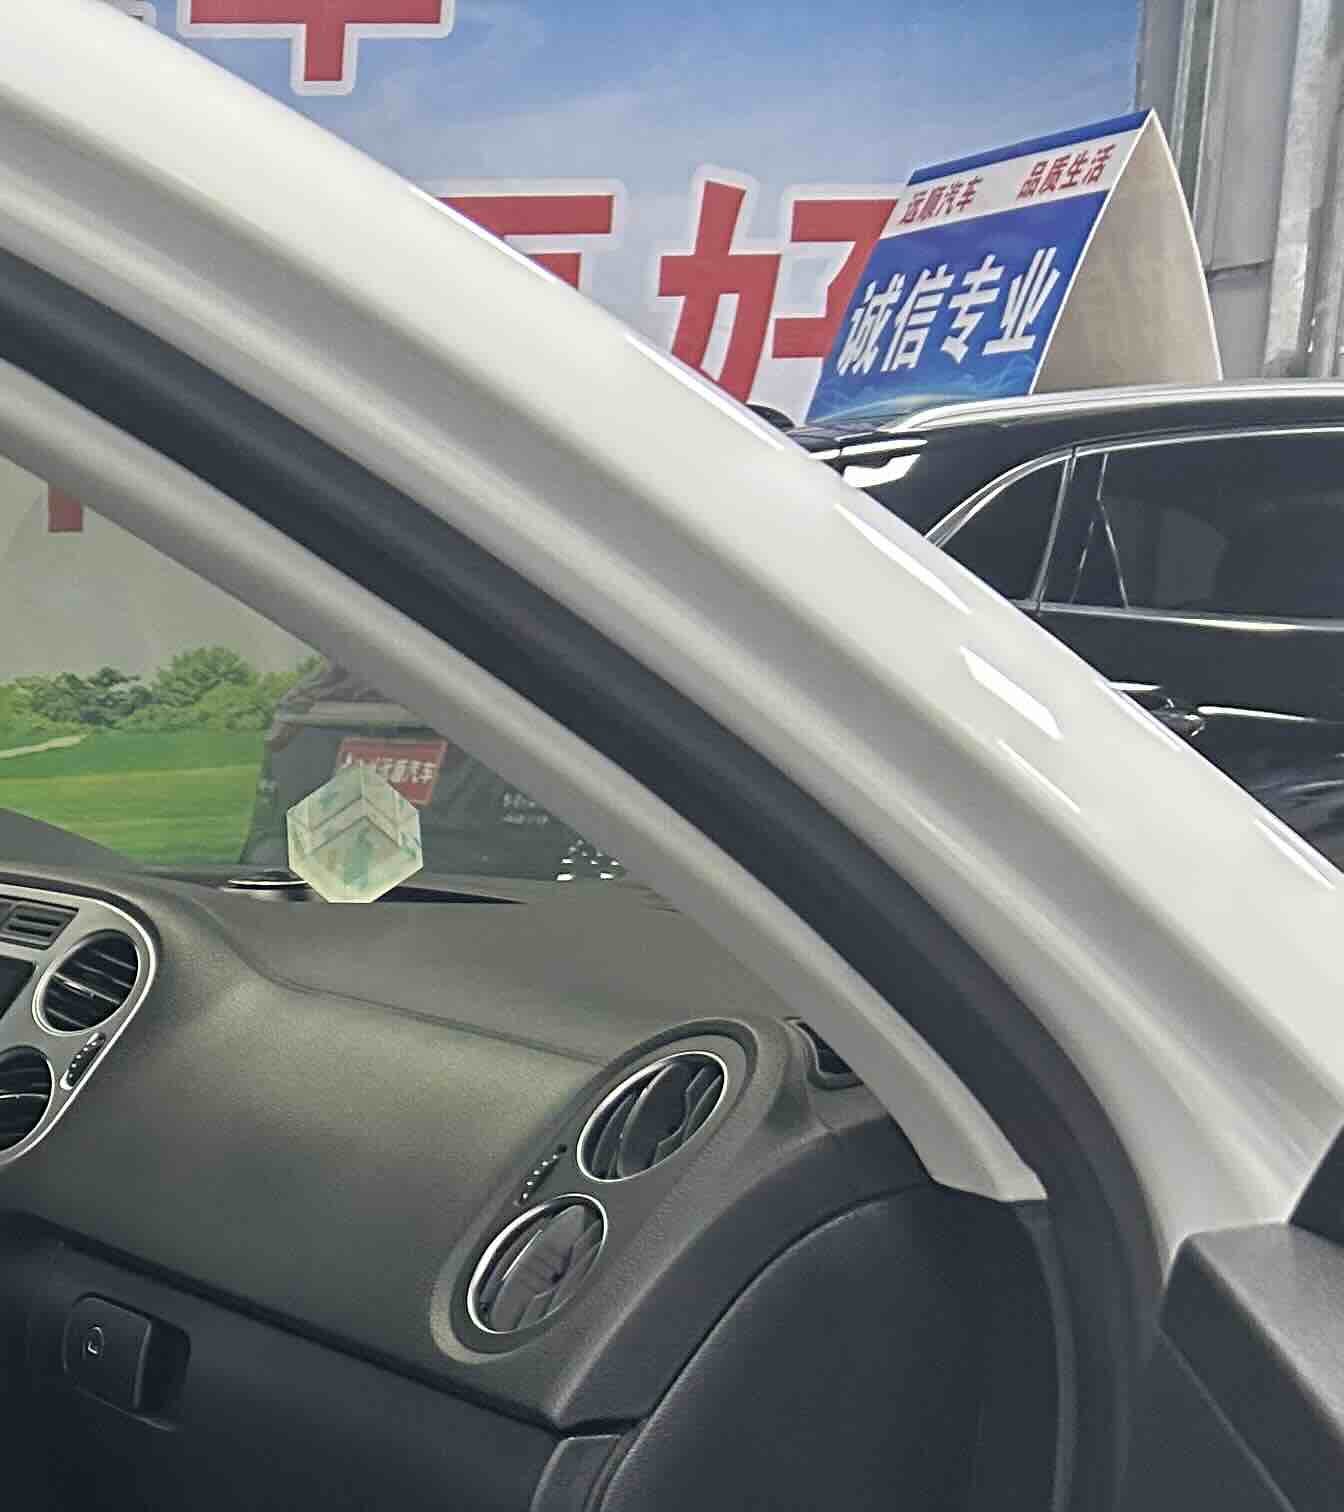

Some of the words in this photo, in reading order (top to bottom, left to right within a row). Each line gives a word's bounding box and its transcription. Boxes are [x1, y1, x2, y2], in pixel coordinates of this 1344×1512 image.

[1015, 144, 1116, 201] 品质生活
[835, 246, 1060, 377] 诚信专业
